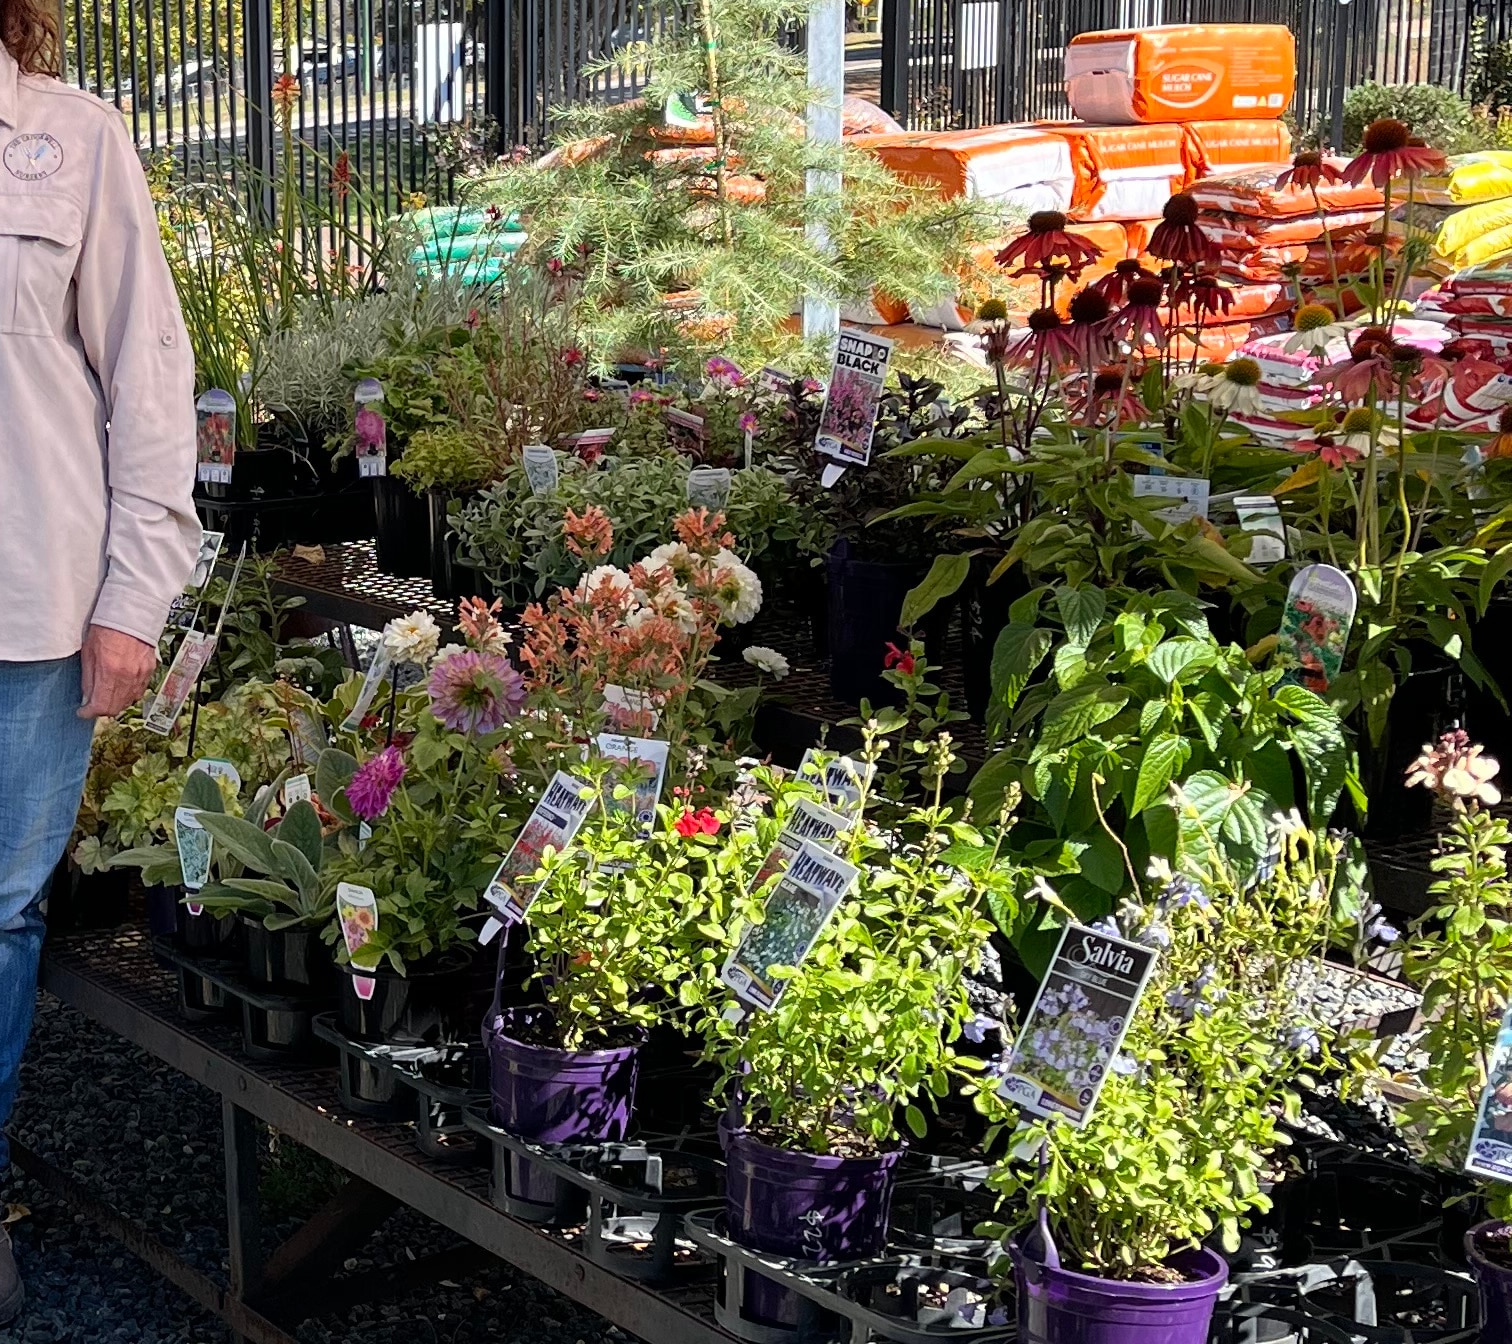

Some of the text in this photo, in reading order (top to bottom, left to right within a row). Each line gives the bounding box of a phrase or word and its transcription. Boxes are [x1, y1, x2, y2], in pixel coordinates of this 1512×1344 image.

[1161, 82, 1192, 93] MULCH
[1162, 71, 1214, 83] SUGAR CANE
[837, 352, 880, 375] BLACK
[789, 850, 845, 894] HEATWAVE
[1080, 935, 1135, 974] Salvia
[1017, 1083, 1036, 1100] PGA
[798, 1209, 825, 1257] $22
